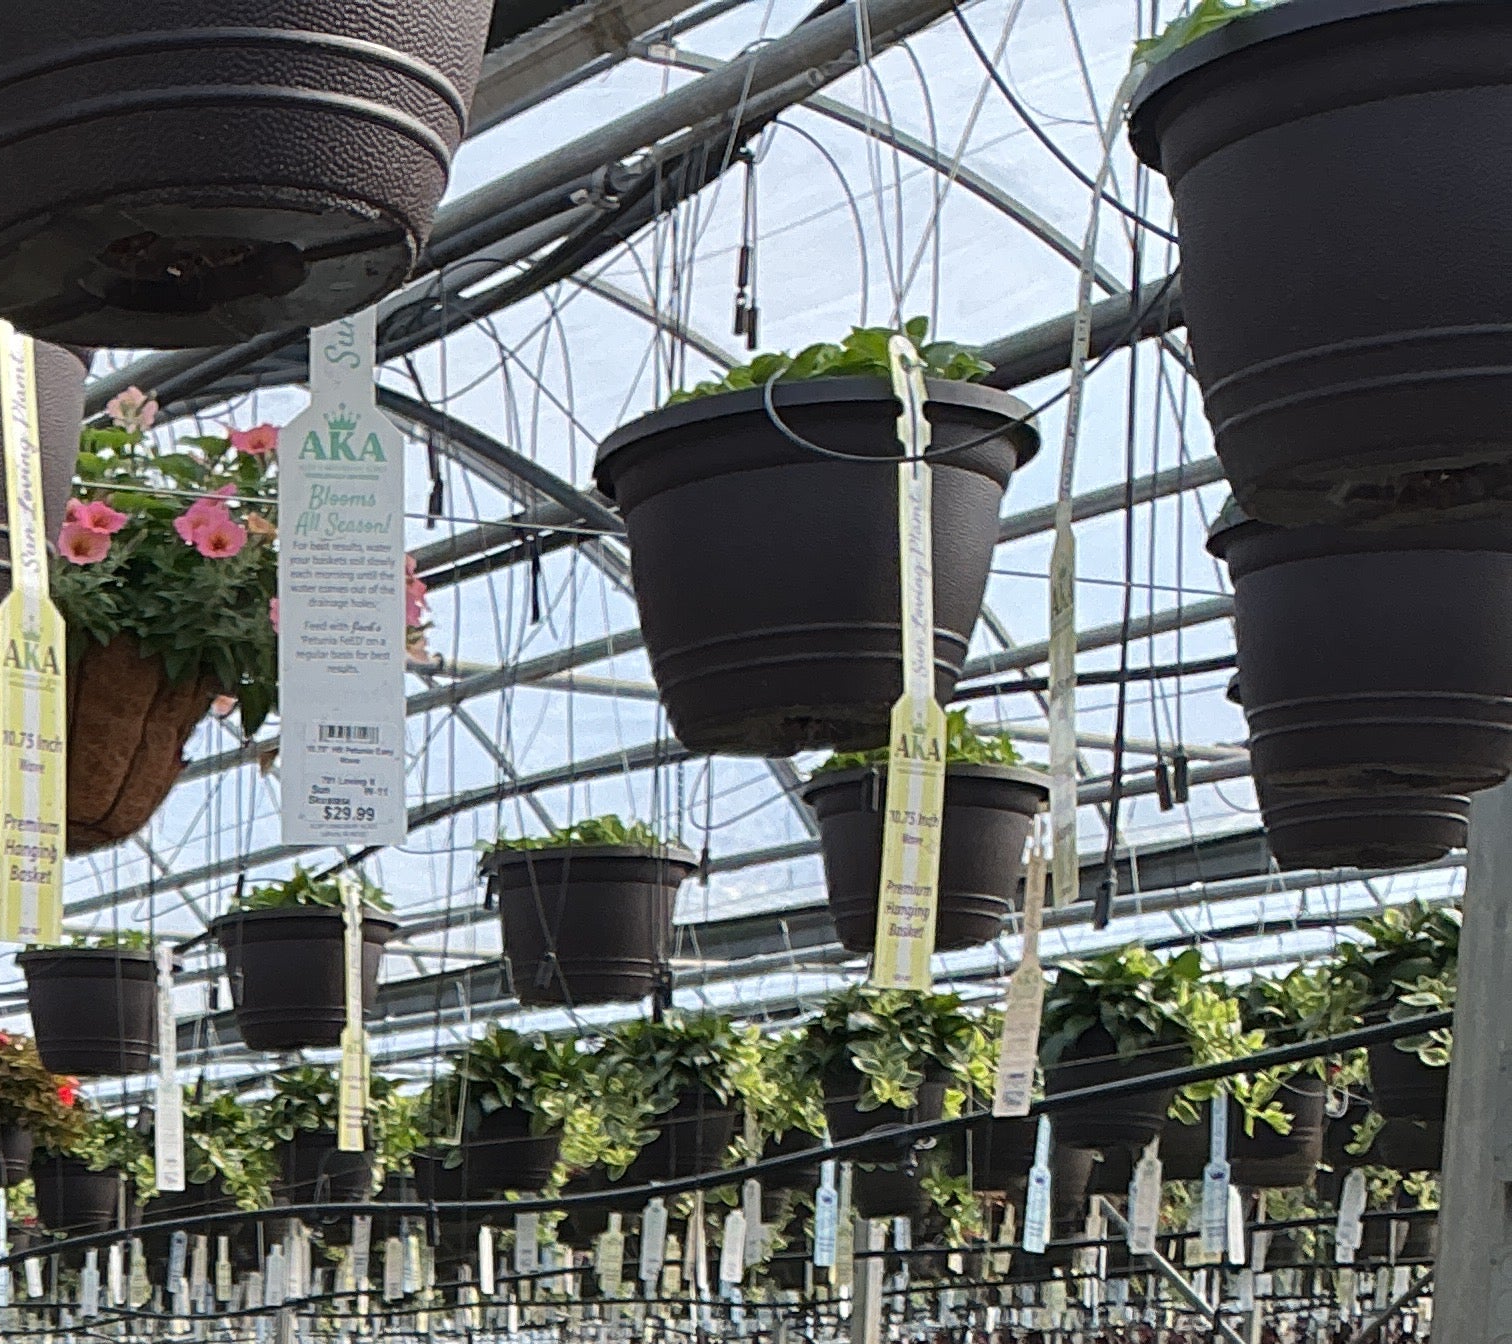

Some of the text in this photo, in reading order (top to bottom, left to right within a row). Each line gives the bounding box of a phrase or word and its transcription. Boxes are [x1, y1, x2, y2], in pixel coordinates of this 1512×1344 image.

[298, 430, 388, 462] AKA
[310, 484, 376, 510] Blooms
[295, 511, 393, 537] All Season!
[3, 638, 61, 676] AKA
[893, 733, 941, 762] AKA
[324, 806, 375, 821] $29.99
